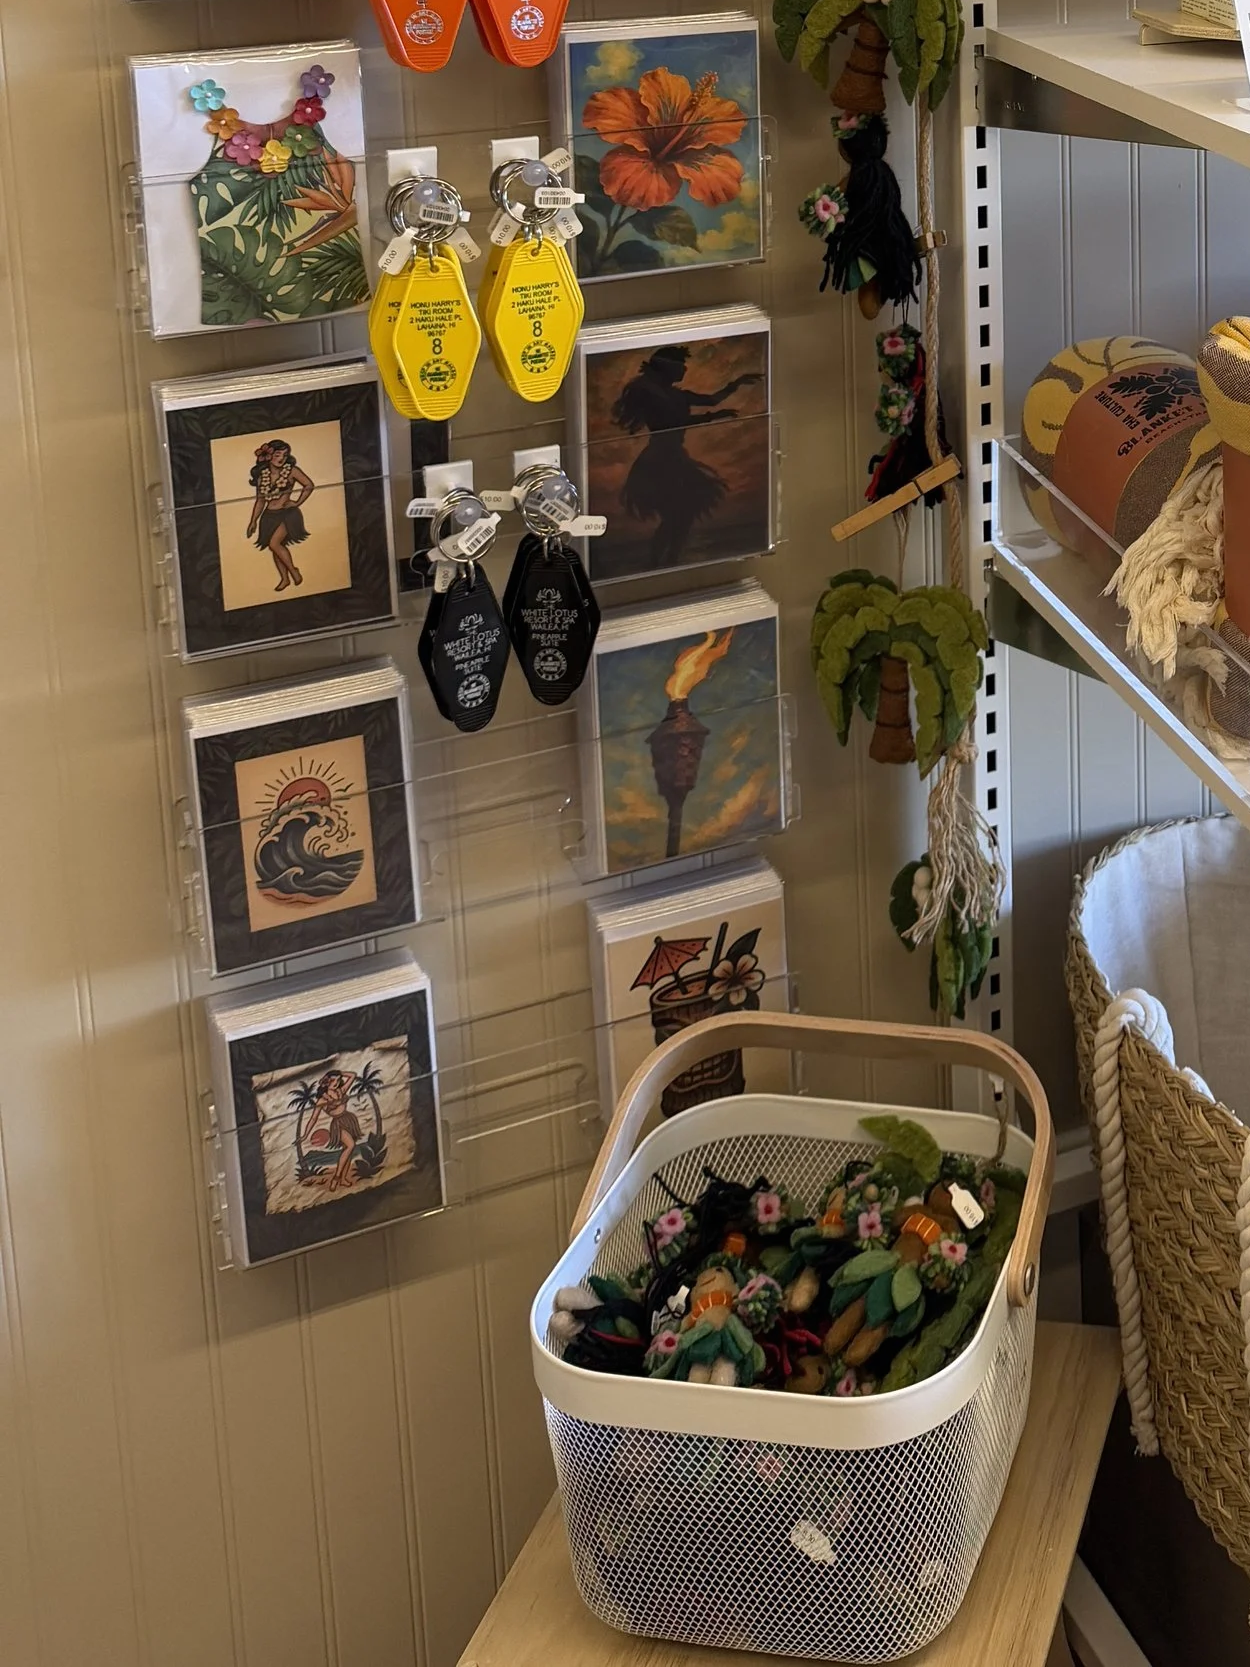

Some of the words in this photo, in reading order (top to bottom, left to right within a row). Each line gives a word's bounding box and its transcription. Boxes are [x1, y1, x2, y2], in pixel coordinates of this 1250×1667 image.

[532, 282, 559, 290] HARRY'S
[533, 290, 552, 298] ROOM
[533, 321, 542, 337] 8
[432, 338, 442, 355] 8
[1095, 391, 1126, 417] CULTURE
[1122, 414, 1140, 430] EHA
[1118, 405, 1193, 456] BLANKET
[550, 609, 578, 618] LOTUS
[444, 636, 470, 650] WHITE
[472, 628, 500, 644] LOTUS
